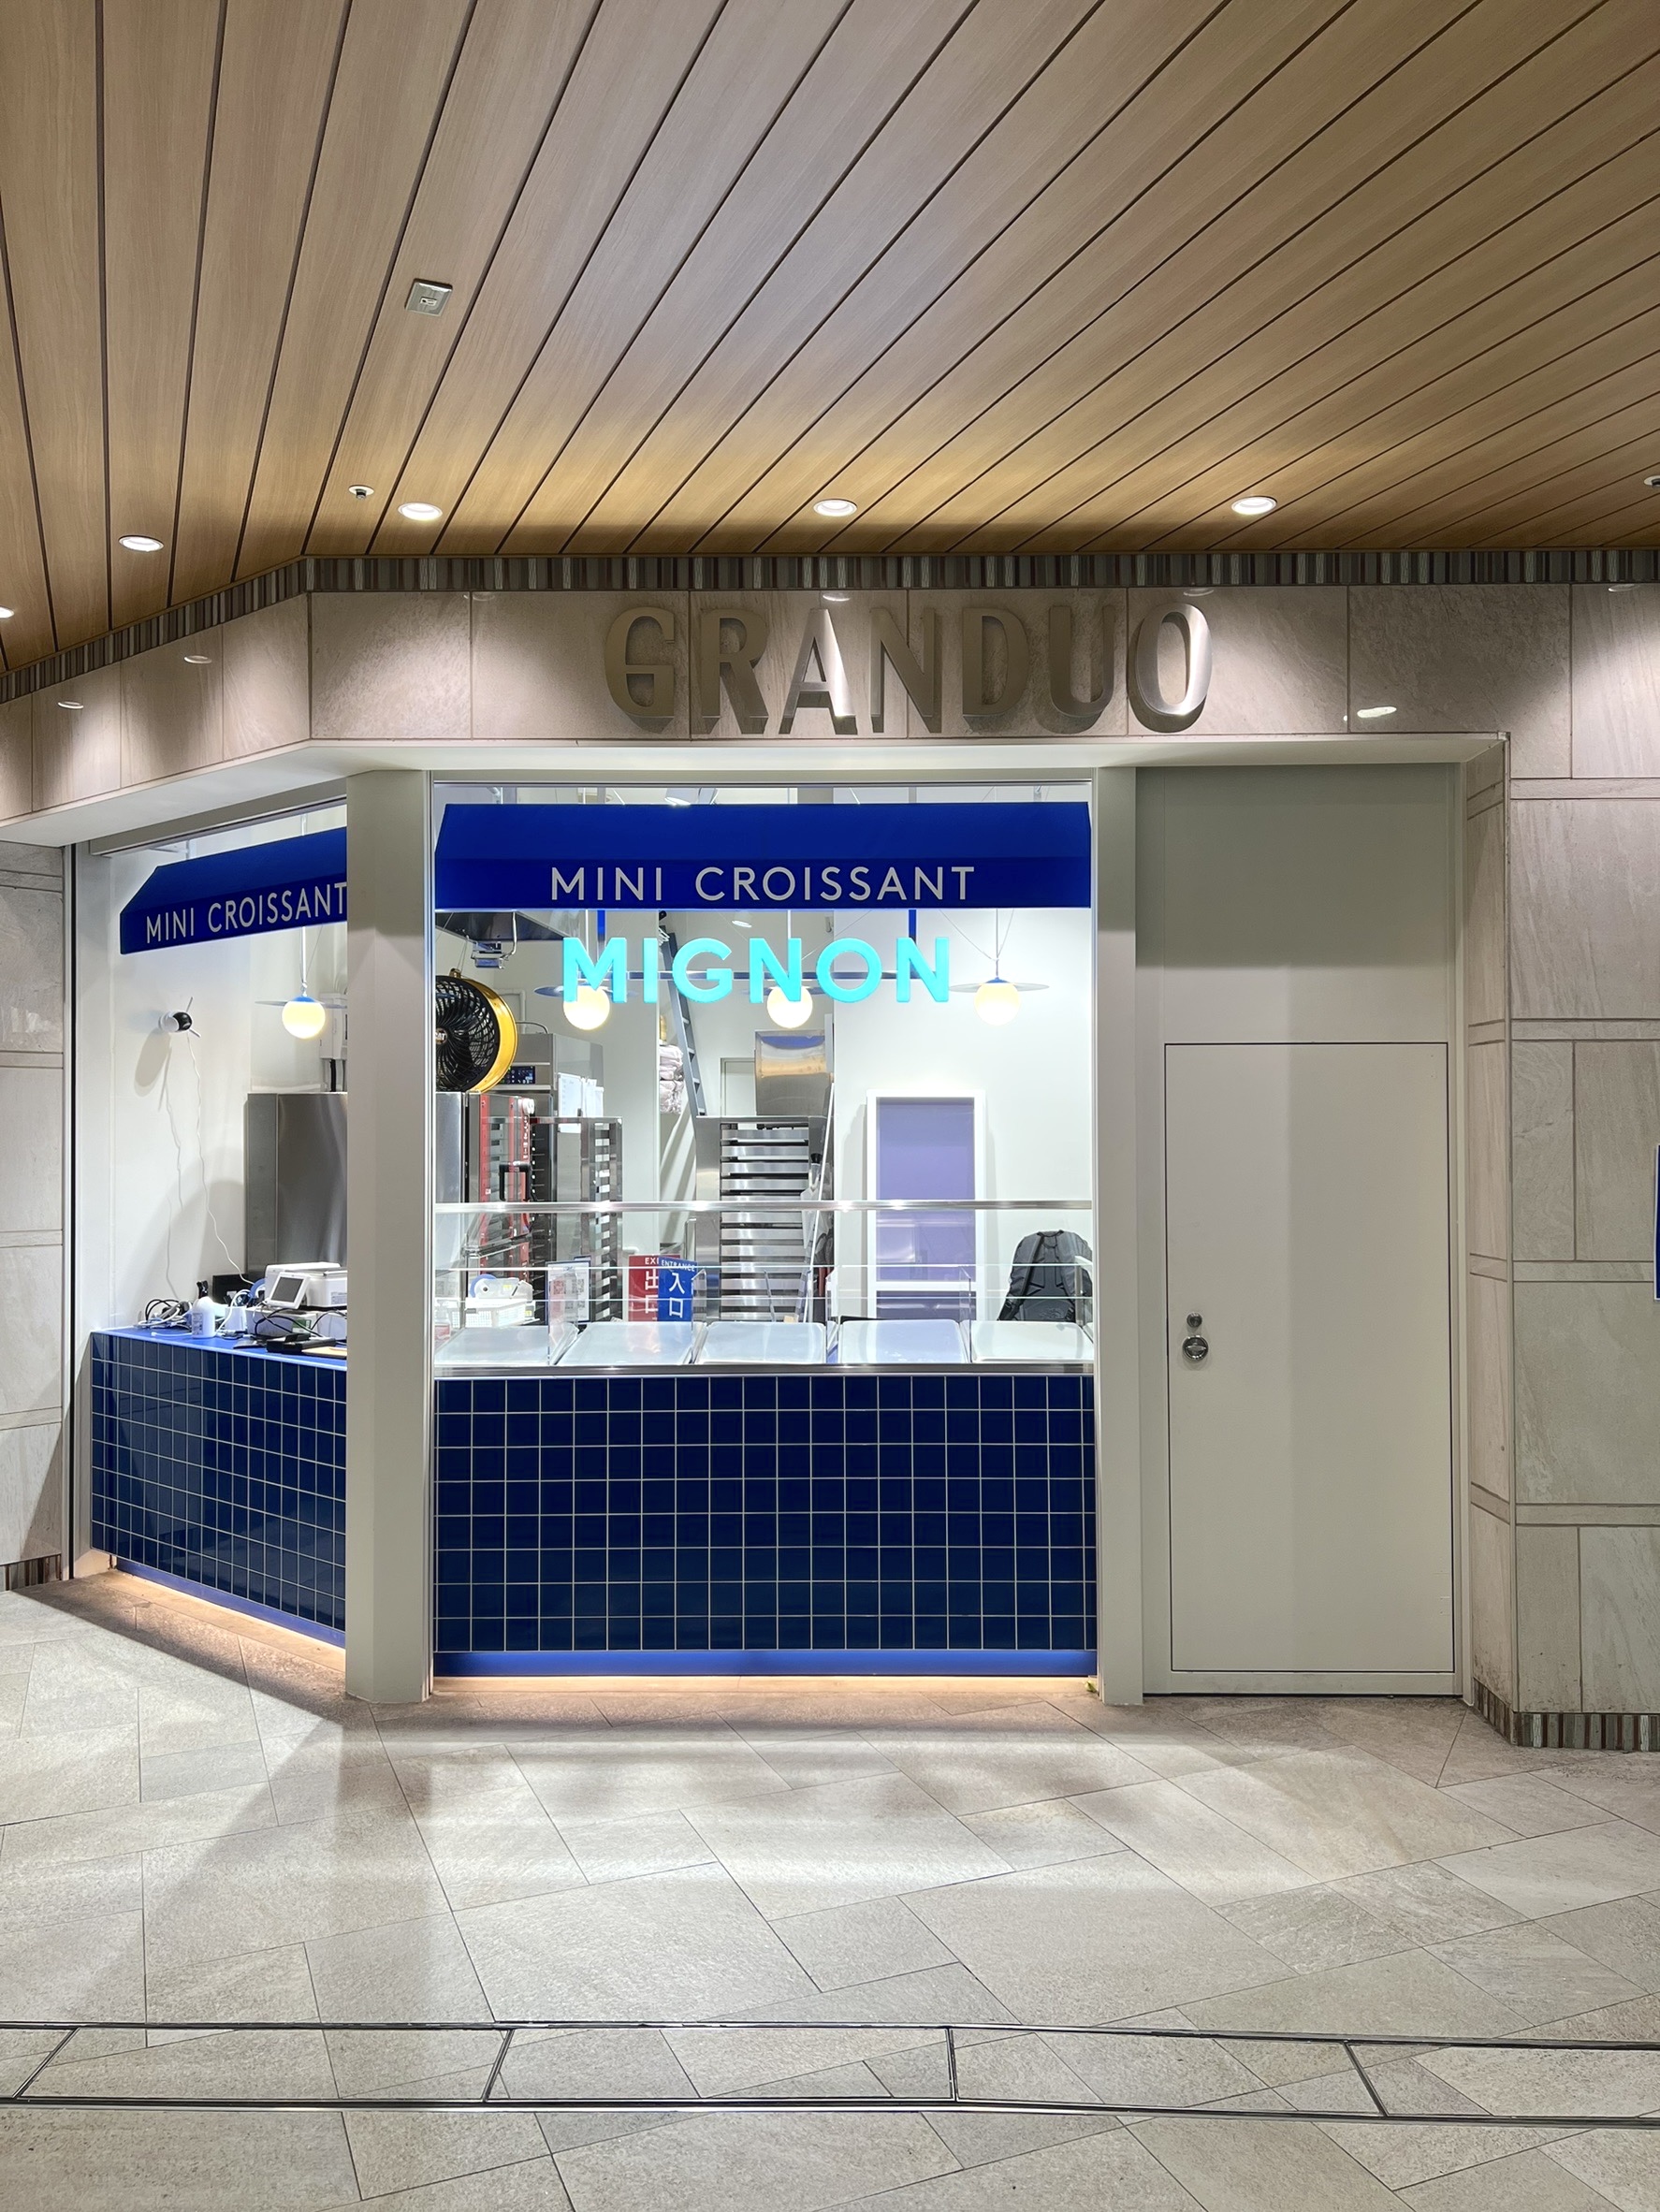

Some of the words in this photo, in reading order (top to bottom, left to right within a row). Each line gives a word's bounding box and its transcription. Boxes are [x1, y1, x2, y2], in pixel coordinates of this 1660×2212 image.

[604, 603, 1213, 718] GRANDUO
[146, 907, 194, 944] MINI
[208, 881, 347, 933] CROISSANT
[551, 866, 662, 901] MINI
[695, 866, 975, 901] CROISSANT
[562, 937, 950, 1003] MIGNON
[669, 1273, 685, 1318] 入口
